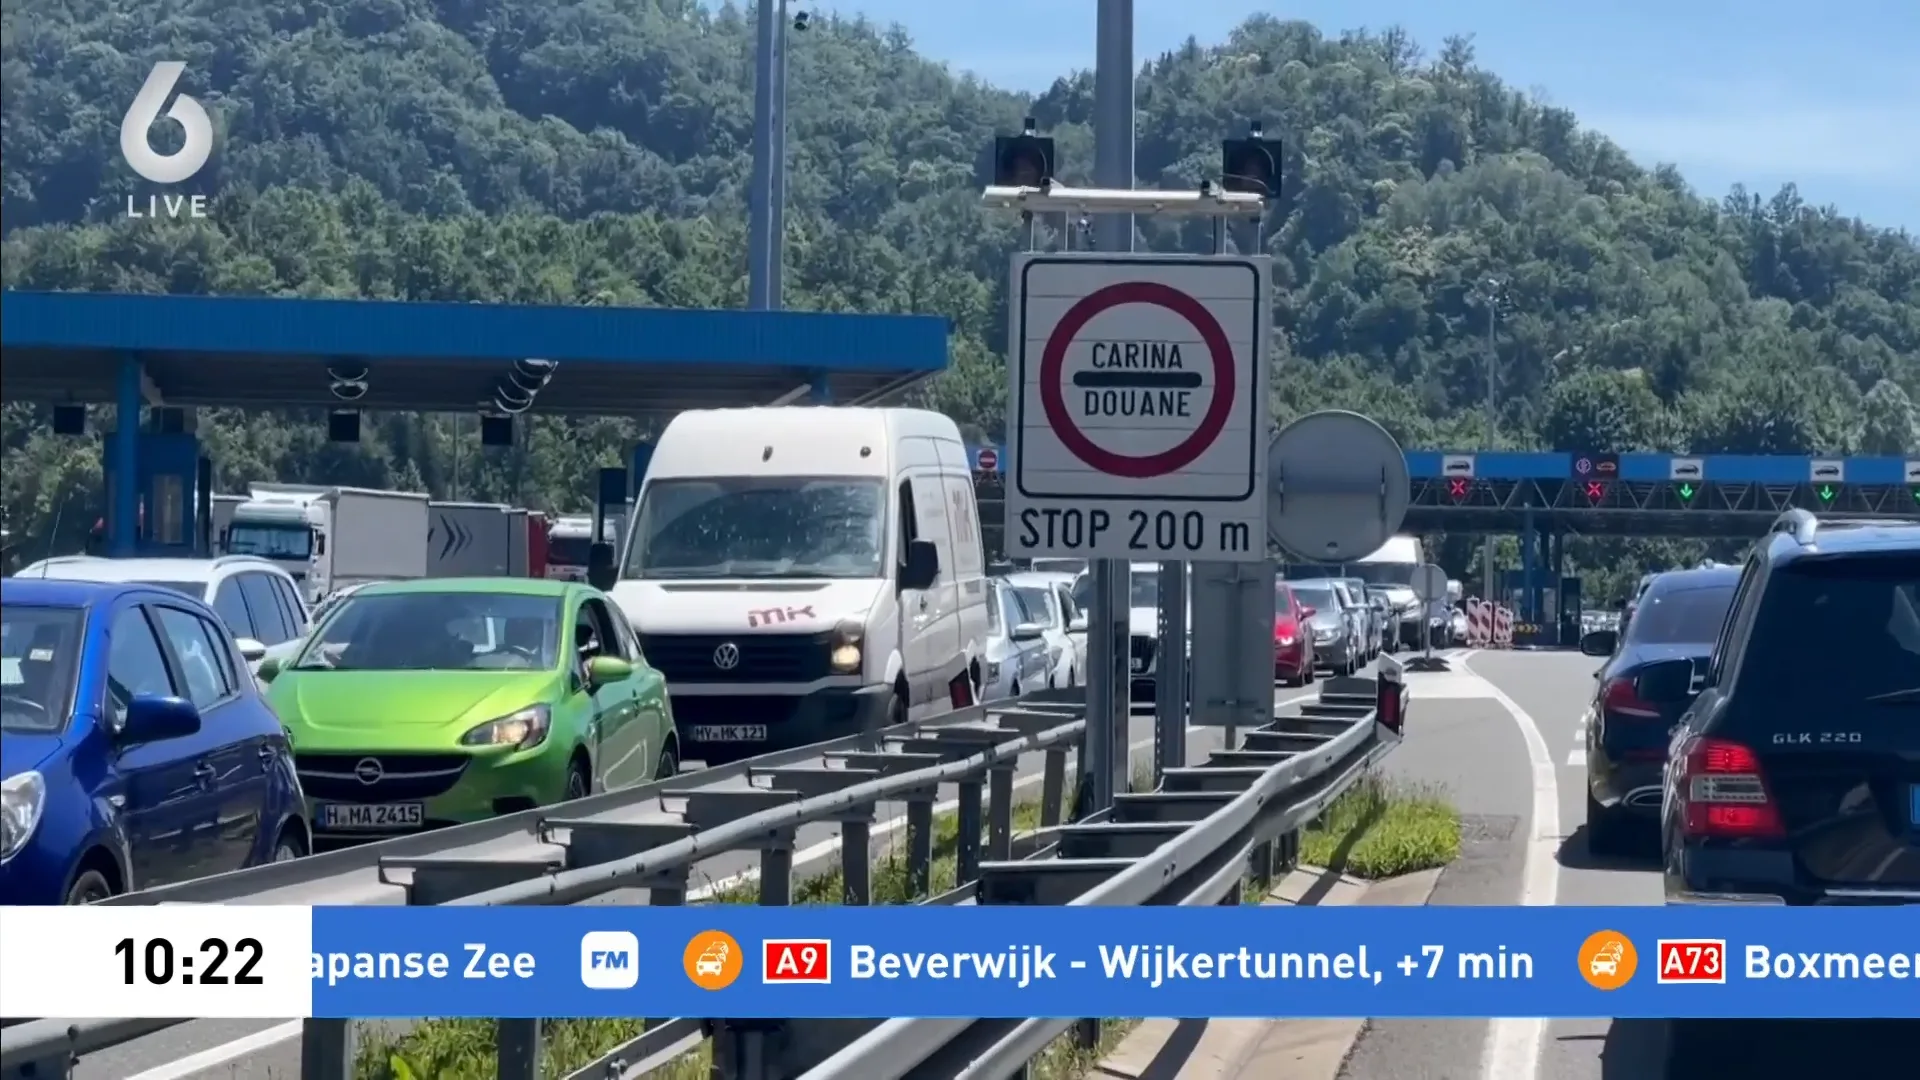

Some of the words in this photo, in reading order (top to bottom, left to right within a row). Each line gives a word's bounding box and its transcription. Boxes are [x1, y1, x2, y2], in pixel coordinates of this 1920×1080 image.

[1091, 342, 1184, 370] CARINA
[1084, 390, 1192, 418] DOUANE
[1019, 507, 1111, 549] STOP
[1127, 509, 1205, 551] 200
[1219, 521, 1250, 552] m
[1772, 733, 1812, 744] GLK
[1819, 732, 1862, 743] 220
[327, 806, 339, 825] H
[376, 805, 420, 823] 2415
